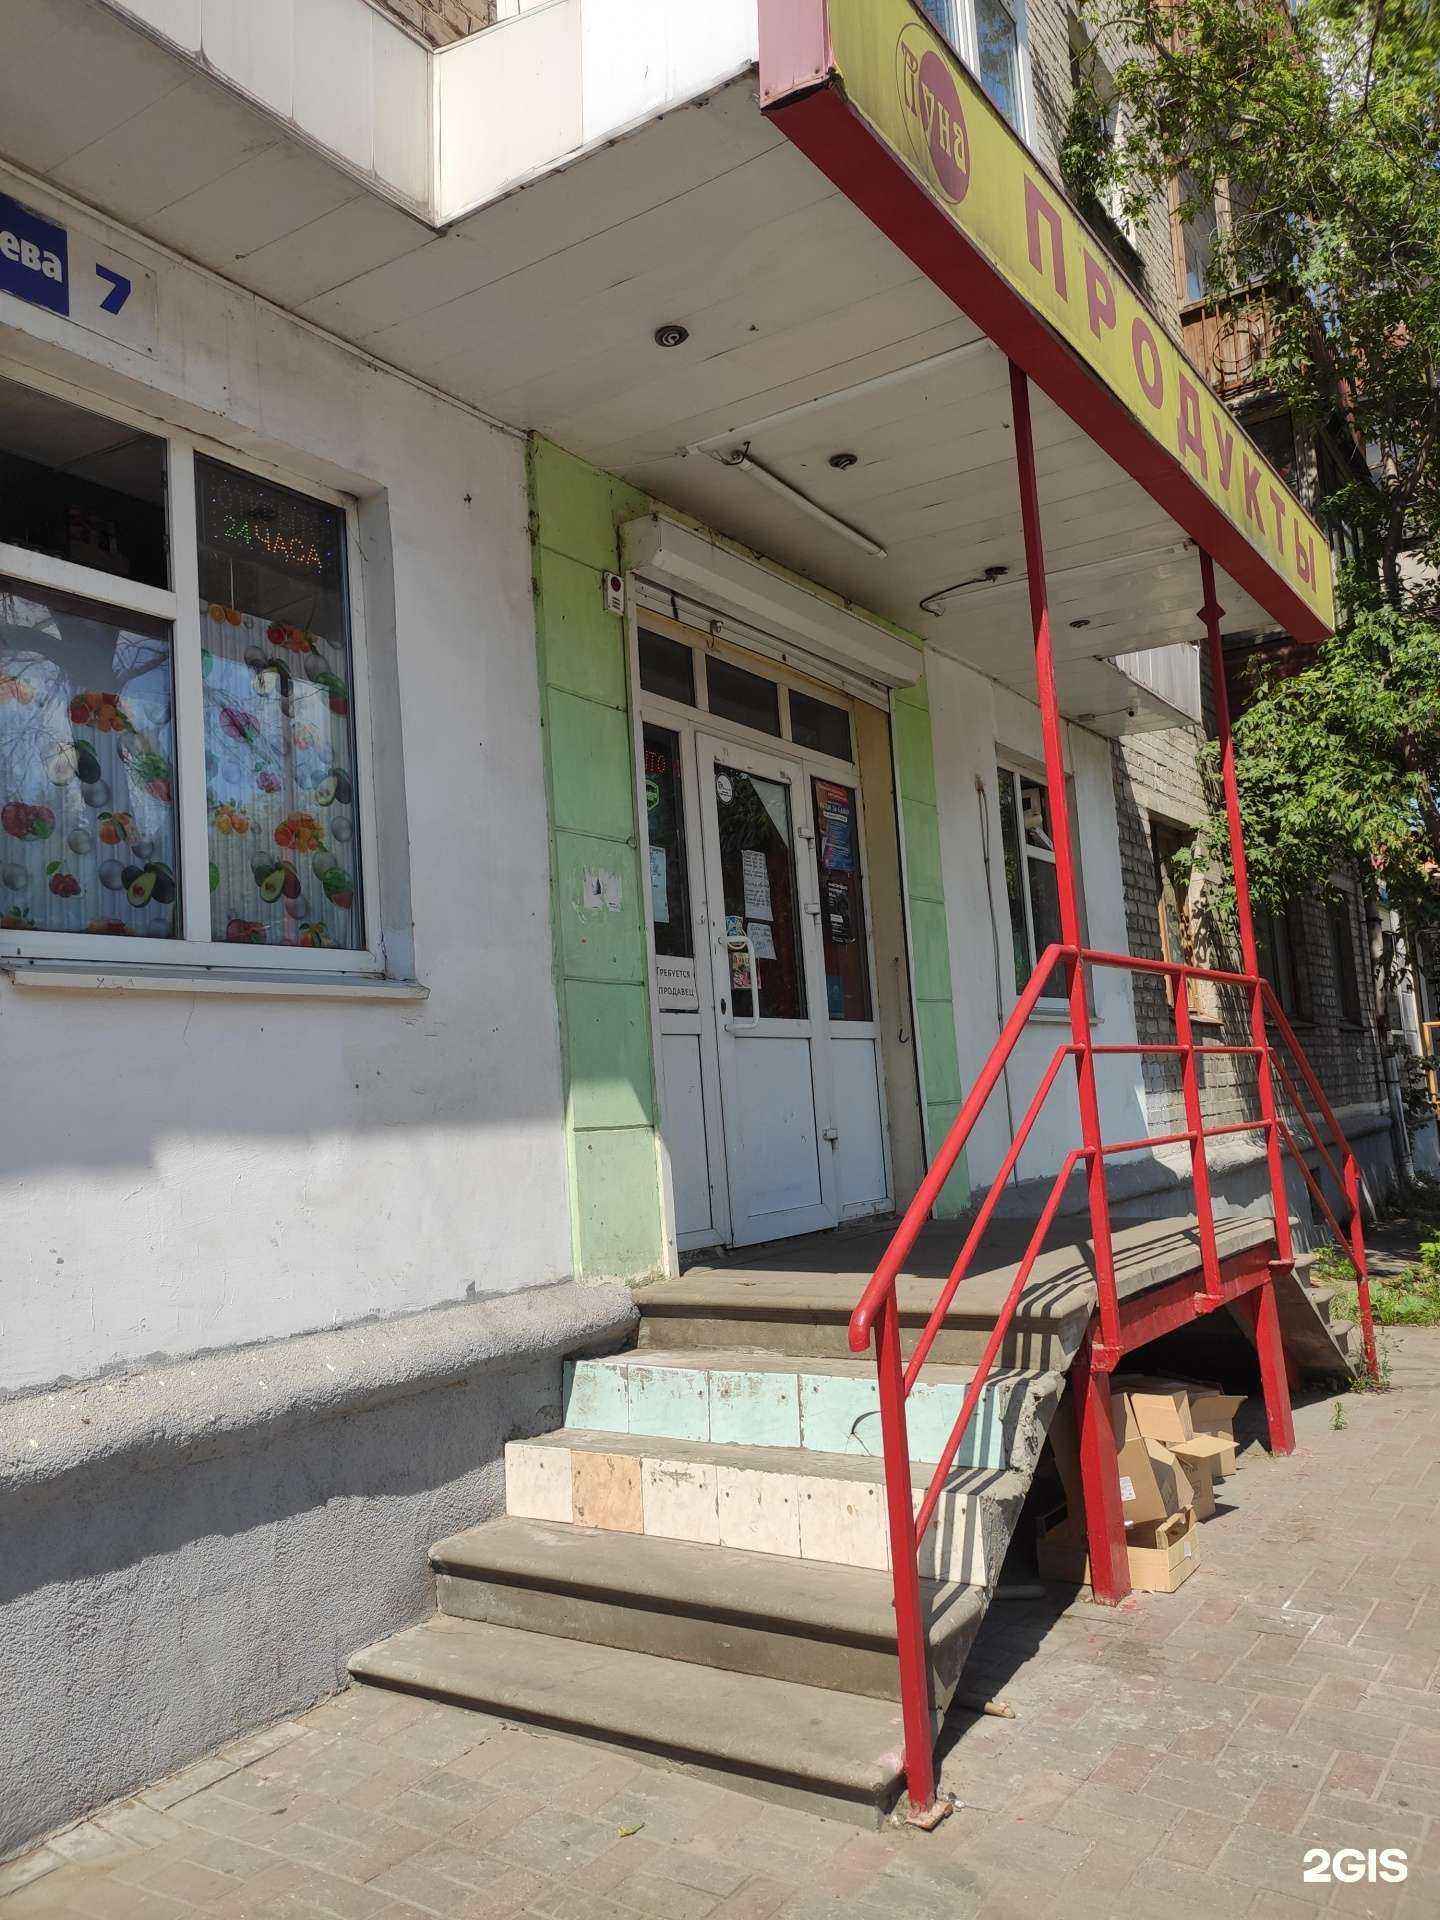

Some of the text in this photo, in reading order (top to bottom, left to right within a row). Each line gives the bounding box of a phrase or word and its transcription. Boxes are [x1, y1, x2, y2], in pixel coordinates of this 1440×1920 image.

[0, 230, 131, 315] ева 7
[1024, 173, 1317, 593] ПРОДУКТЫ
[658, 986, 695, 998] ПРОДАВЕЦ
